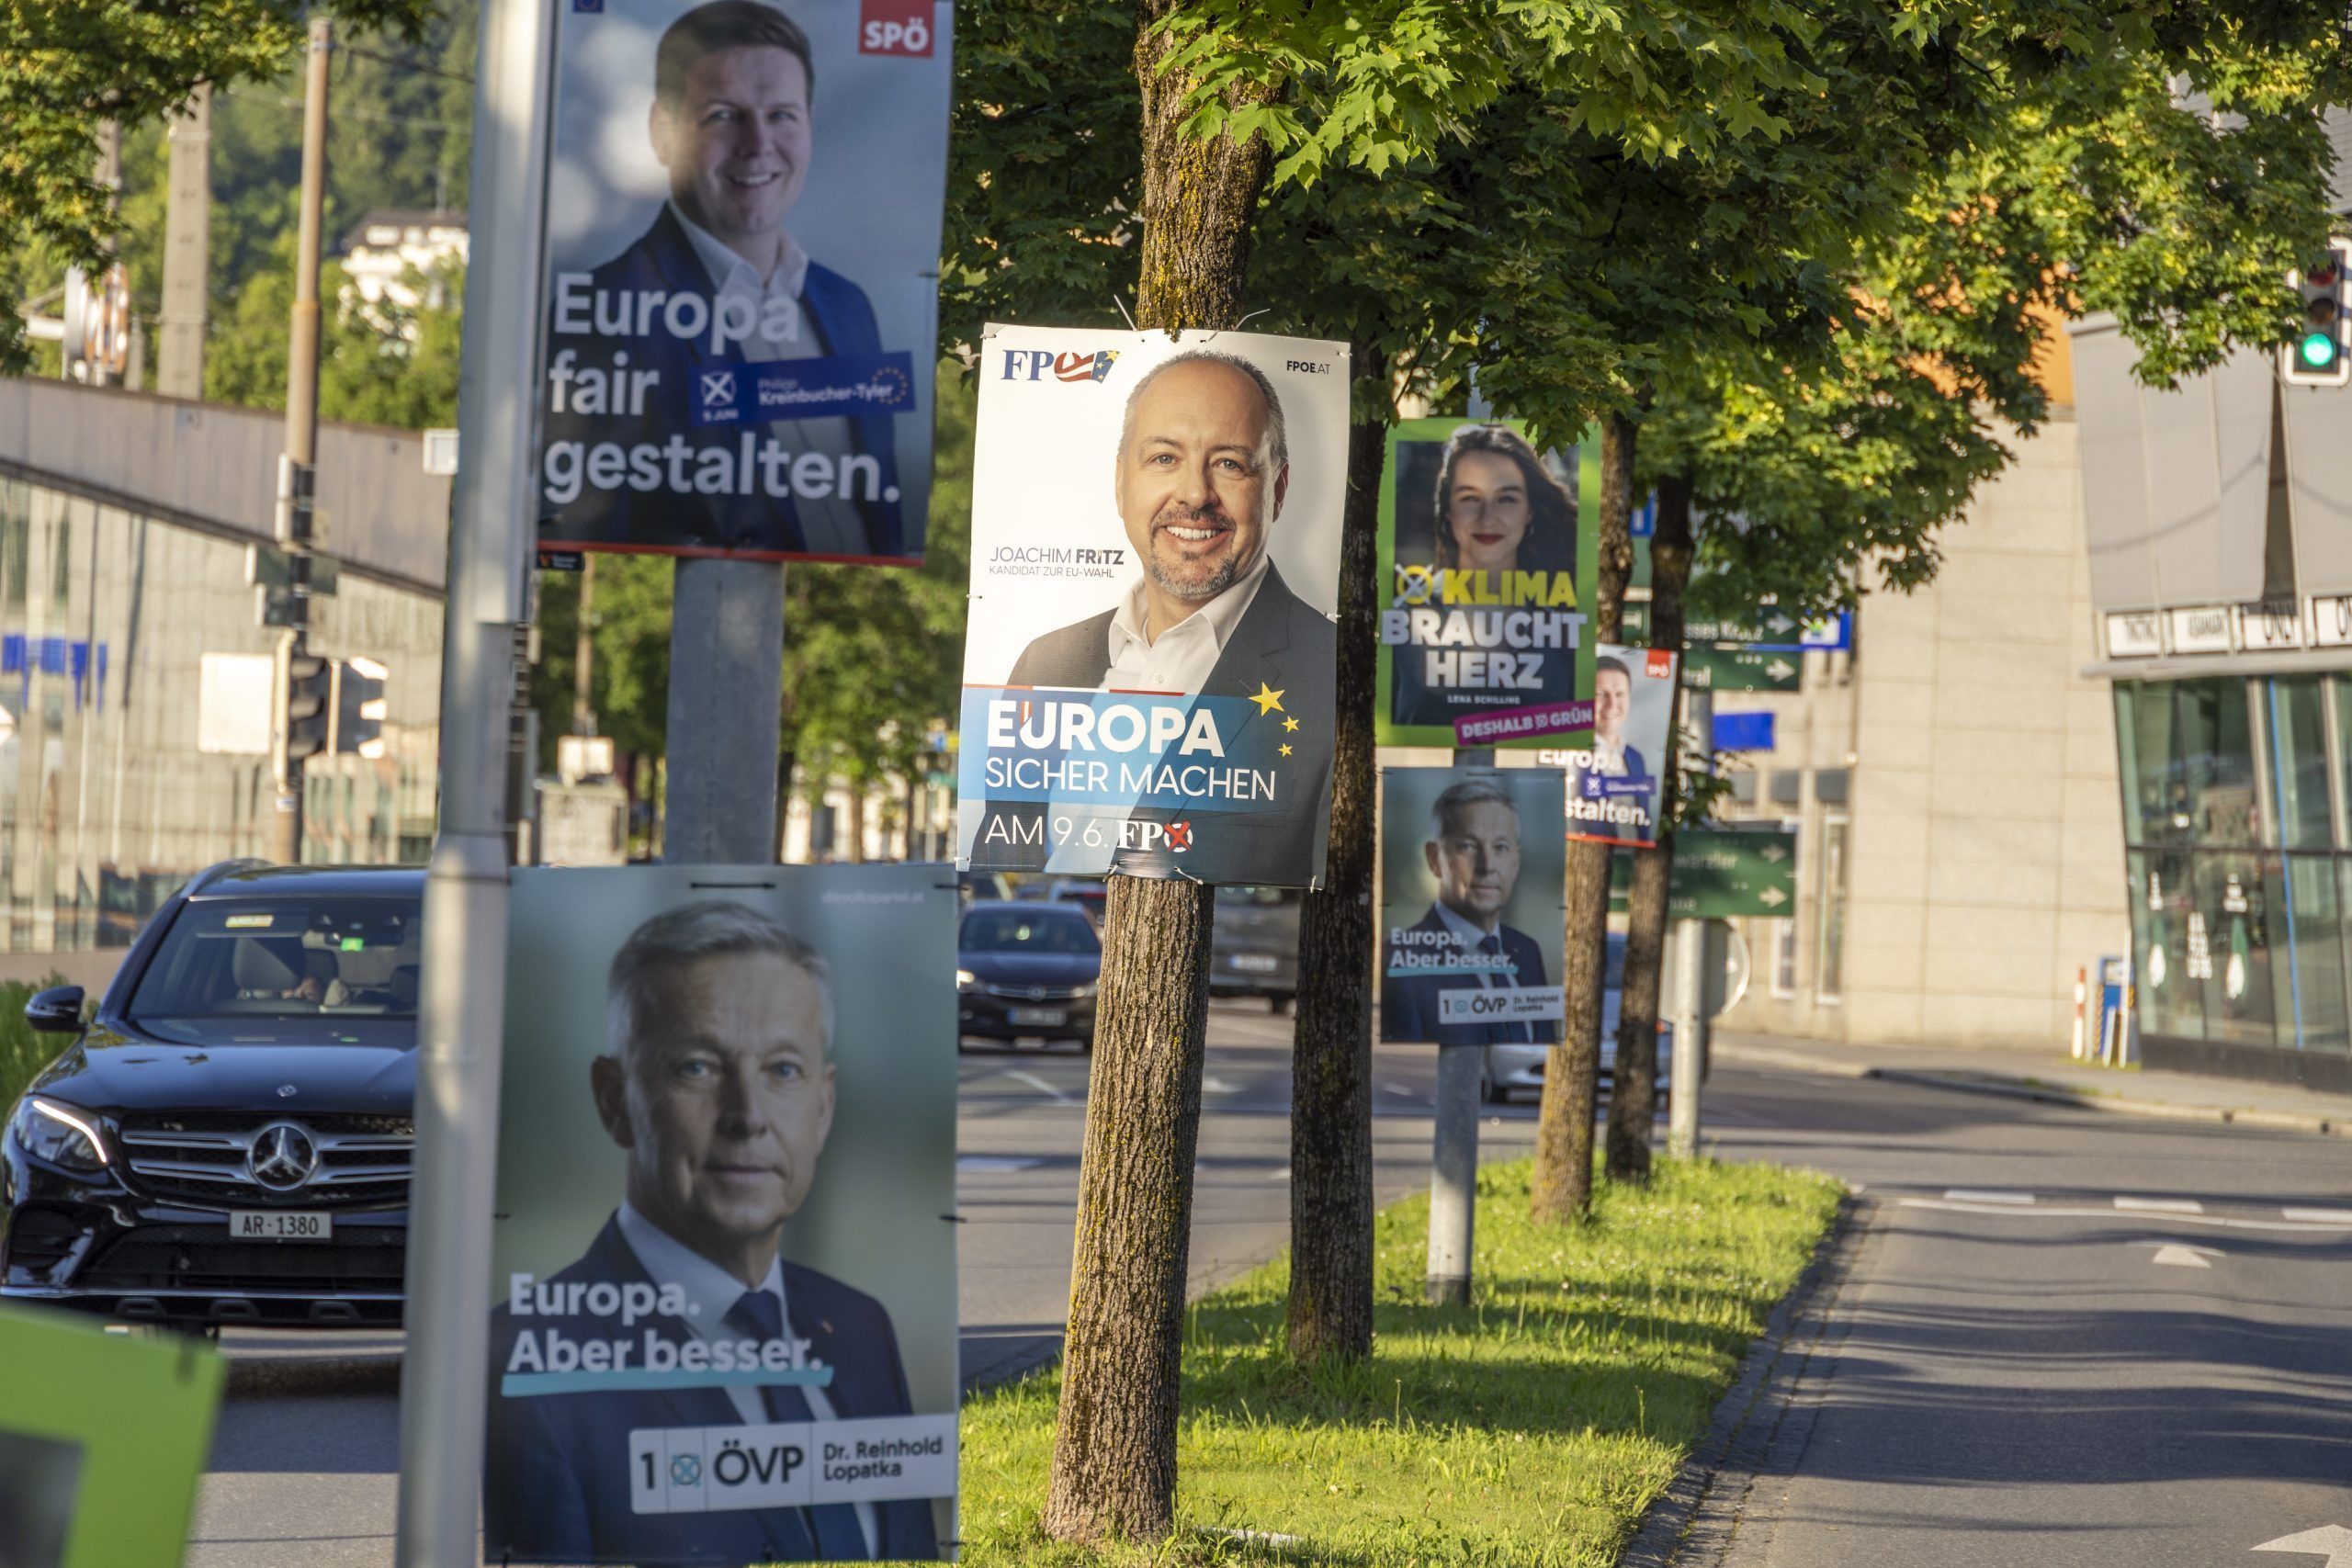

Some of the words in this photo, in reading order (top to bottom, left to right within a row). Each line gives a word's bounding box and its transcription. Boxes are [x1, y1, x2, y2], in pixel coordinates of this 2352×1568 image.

[864, 17, 930, 52] SPÖ
[554, 273, 800, 355] Europa
[548, 348, 660, 416] fair
[1287, 359, 1330, 376] FPOE.AT
[758, 383, 893, 405] Kreinbucher-Tyler
[543, 432, 900, 503] gestalten.
[989, 547, 1071, 564] JOACHIM
[989, 565, 1041, 576] KANDIDAT
[1043, 566, 1064, 577] ZUR
[1066, 568, 1114, 579] EU-WAHL
[1442, 569, 1578, 607] KLIMA
[1381, 609, 1588, 649] BRAUCHT
[1426, 651, 1544, 689] HERZ
[1646, 663, 1669, 677] SPÖ
[1447, 694, 1472, 704] LENA
[1474, 695, 1521, 705] SCHILLING
[987, 700, 1225, 758] EUROPA
[1461, 716, 1533, 738] DESHALB
[1550, 705, 1592, 727] GRÜN
[985, 757, 1108, 793] SICHER
[1120, 762, 1276, 802] MACHEN
[1566, 798, 1651, 826] stalten.
[984, 814, 1044, 846] AM
[1054, 816, 1108, 849] 9.6.
[1390, 928, 1468, 949] Europa.
[1391, 950, 1442, 968] Aber
[1445, 950, 1515, 969] besser.
[1443, 998, 1450, 1014] 1
[1472, 994, 1507, 1014] ÖVP
[243, 1214, 264, 1234] AR
[277, 1215, 319, 1235] 1380
[509, 1273, 701, 1325] Europa.
[507, 1328, 633, 1373] Aber
[645, 1328, 823, 1373] besser.
[640, 1451, 655, 1490] 1
[713, 1438, 804, 1487] ÖVP
[823, 1442, 849, 1461] Dr.
[856, 1436, 942, 1459] Reinhold
[823, 1460, 901, 1482] Lopatka
